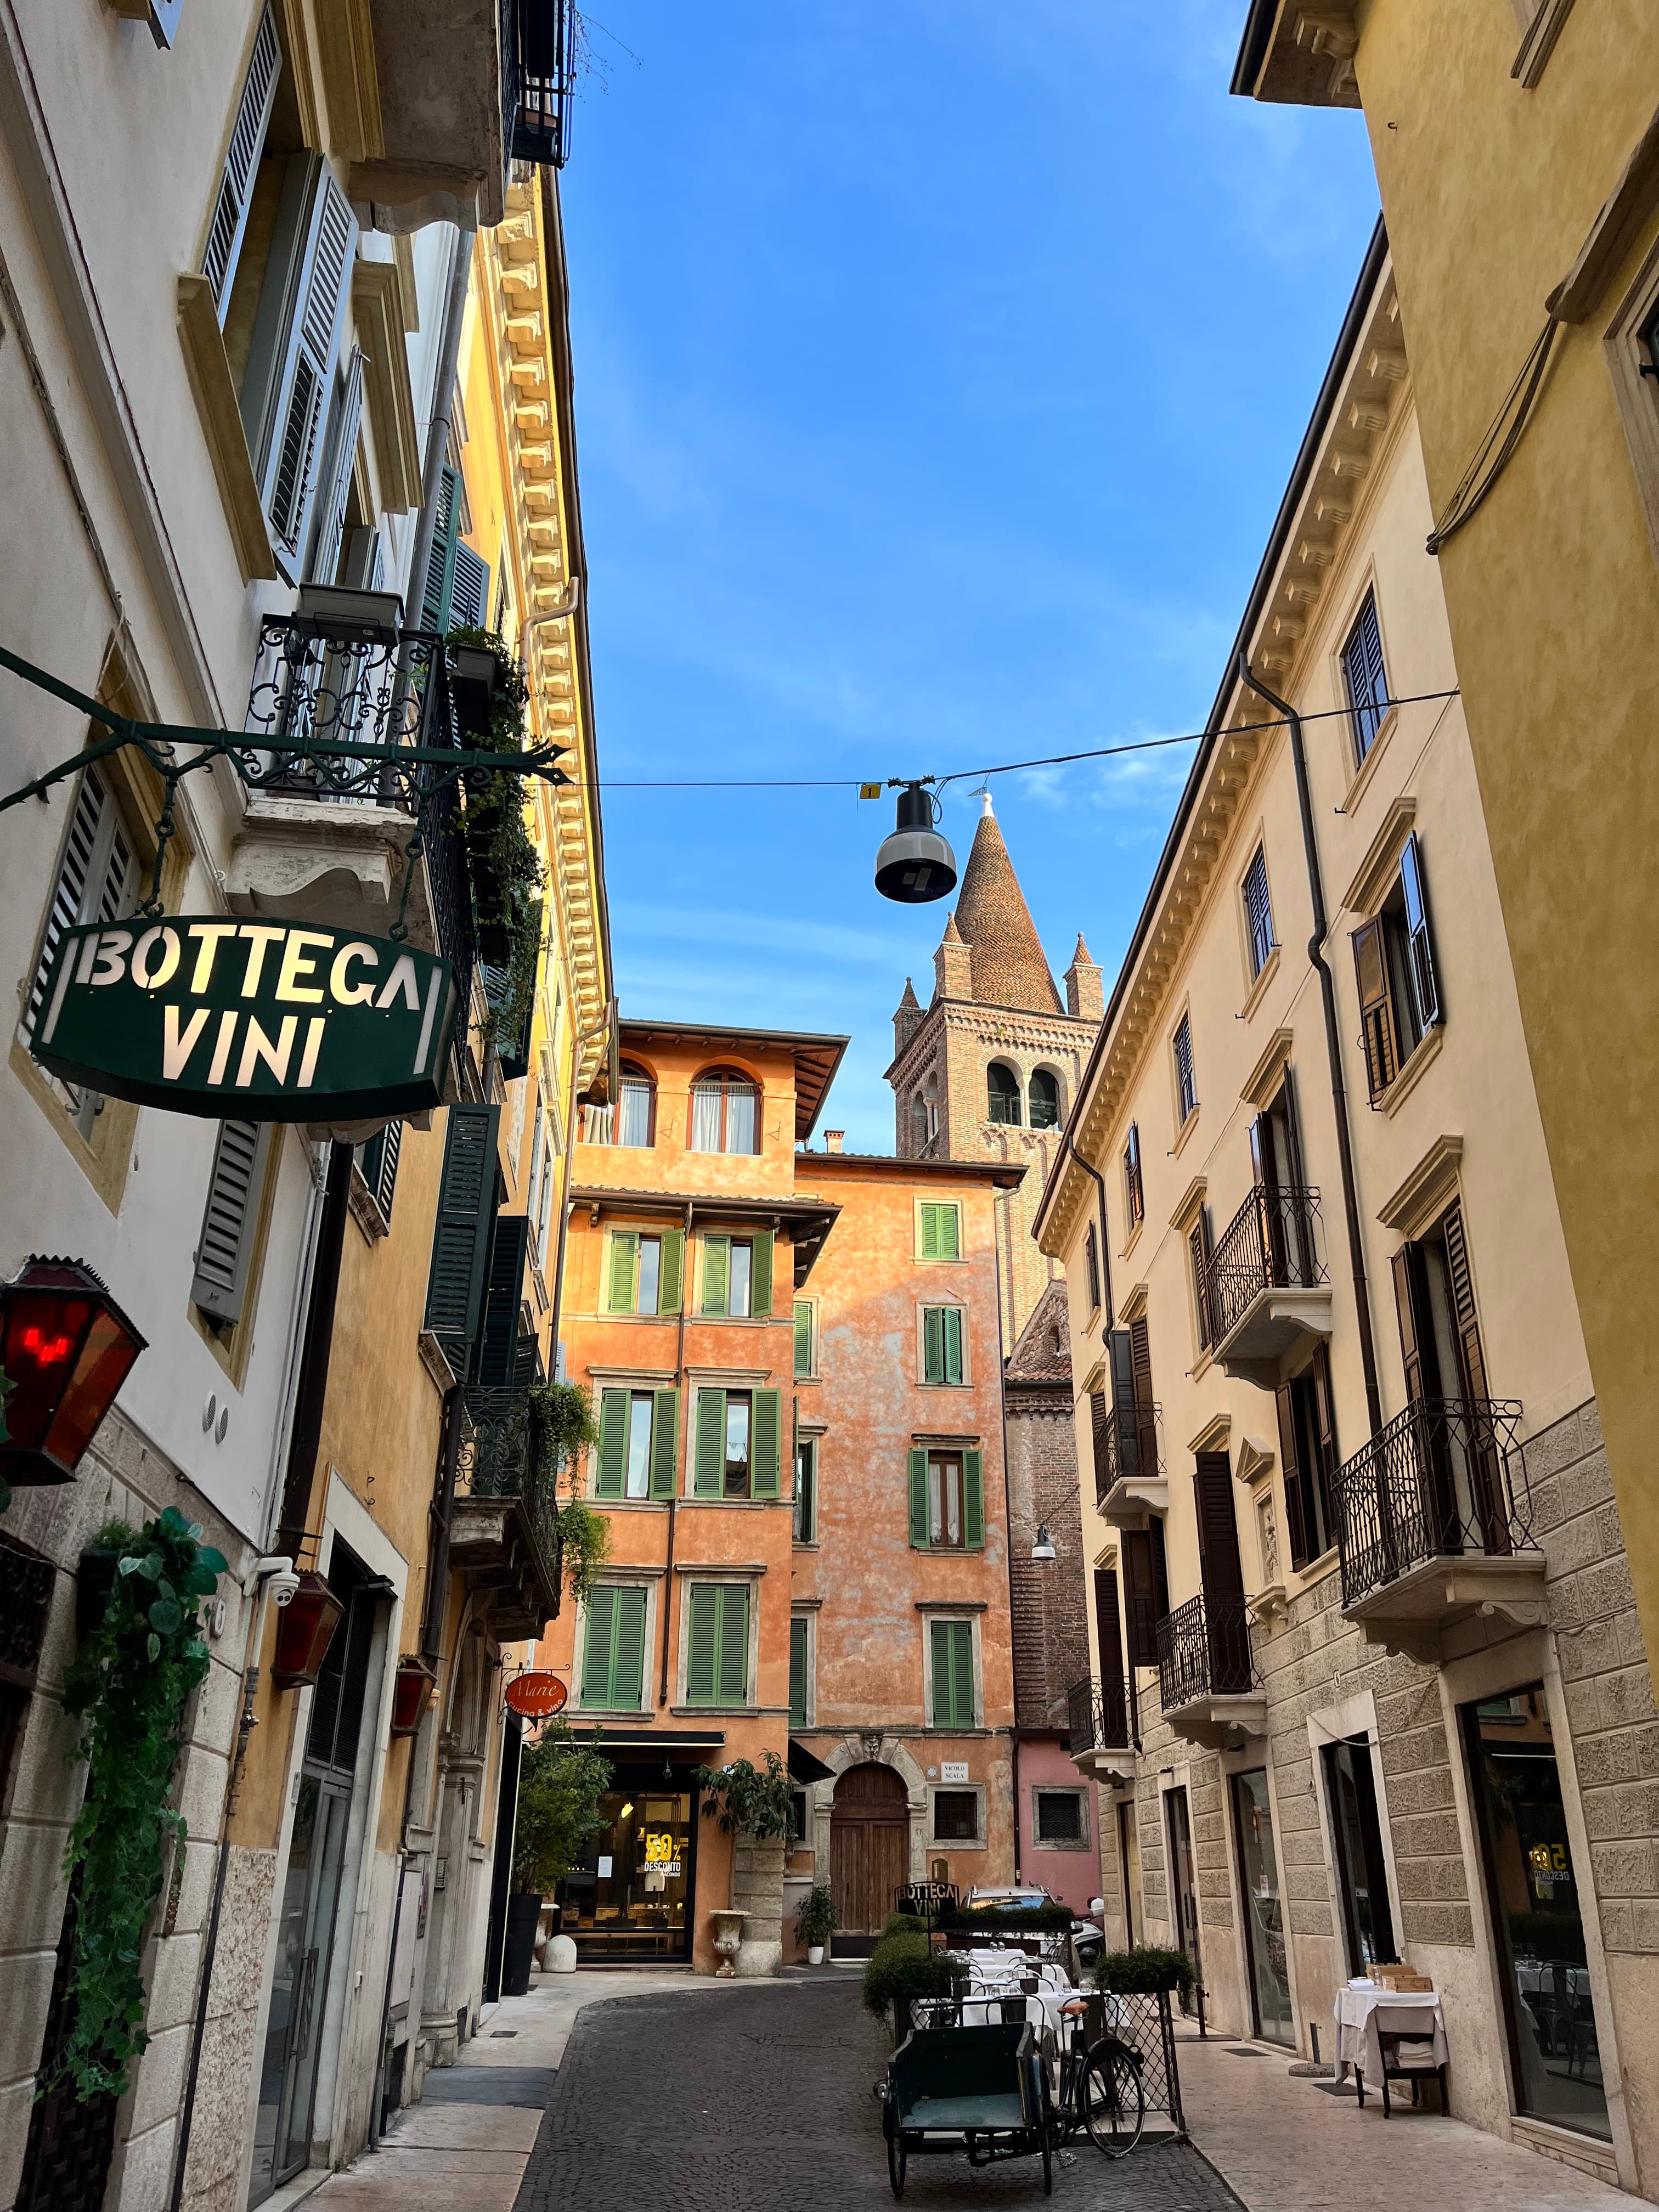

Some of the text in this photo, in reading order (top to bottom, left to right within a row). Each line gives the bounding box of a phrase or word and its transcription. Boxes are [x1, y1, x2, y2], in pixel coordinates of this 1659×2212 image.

[868, 787, 872, 798] 1
[75, 924, 421, 1011] BOTTEGA
[163, 1005, 326, 1088] VINI
[512, 1680, 560, 1696] Marie
[546, 1699, 563, 1713] vino
[646, 1834, 681, 1861] 50%
[644, 1861, 681, 1872] DESCONTO
[898, 1882, 955, 1899] BOTTEGA
[913, 1899, 940, 1916] VINI
